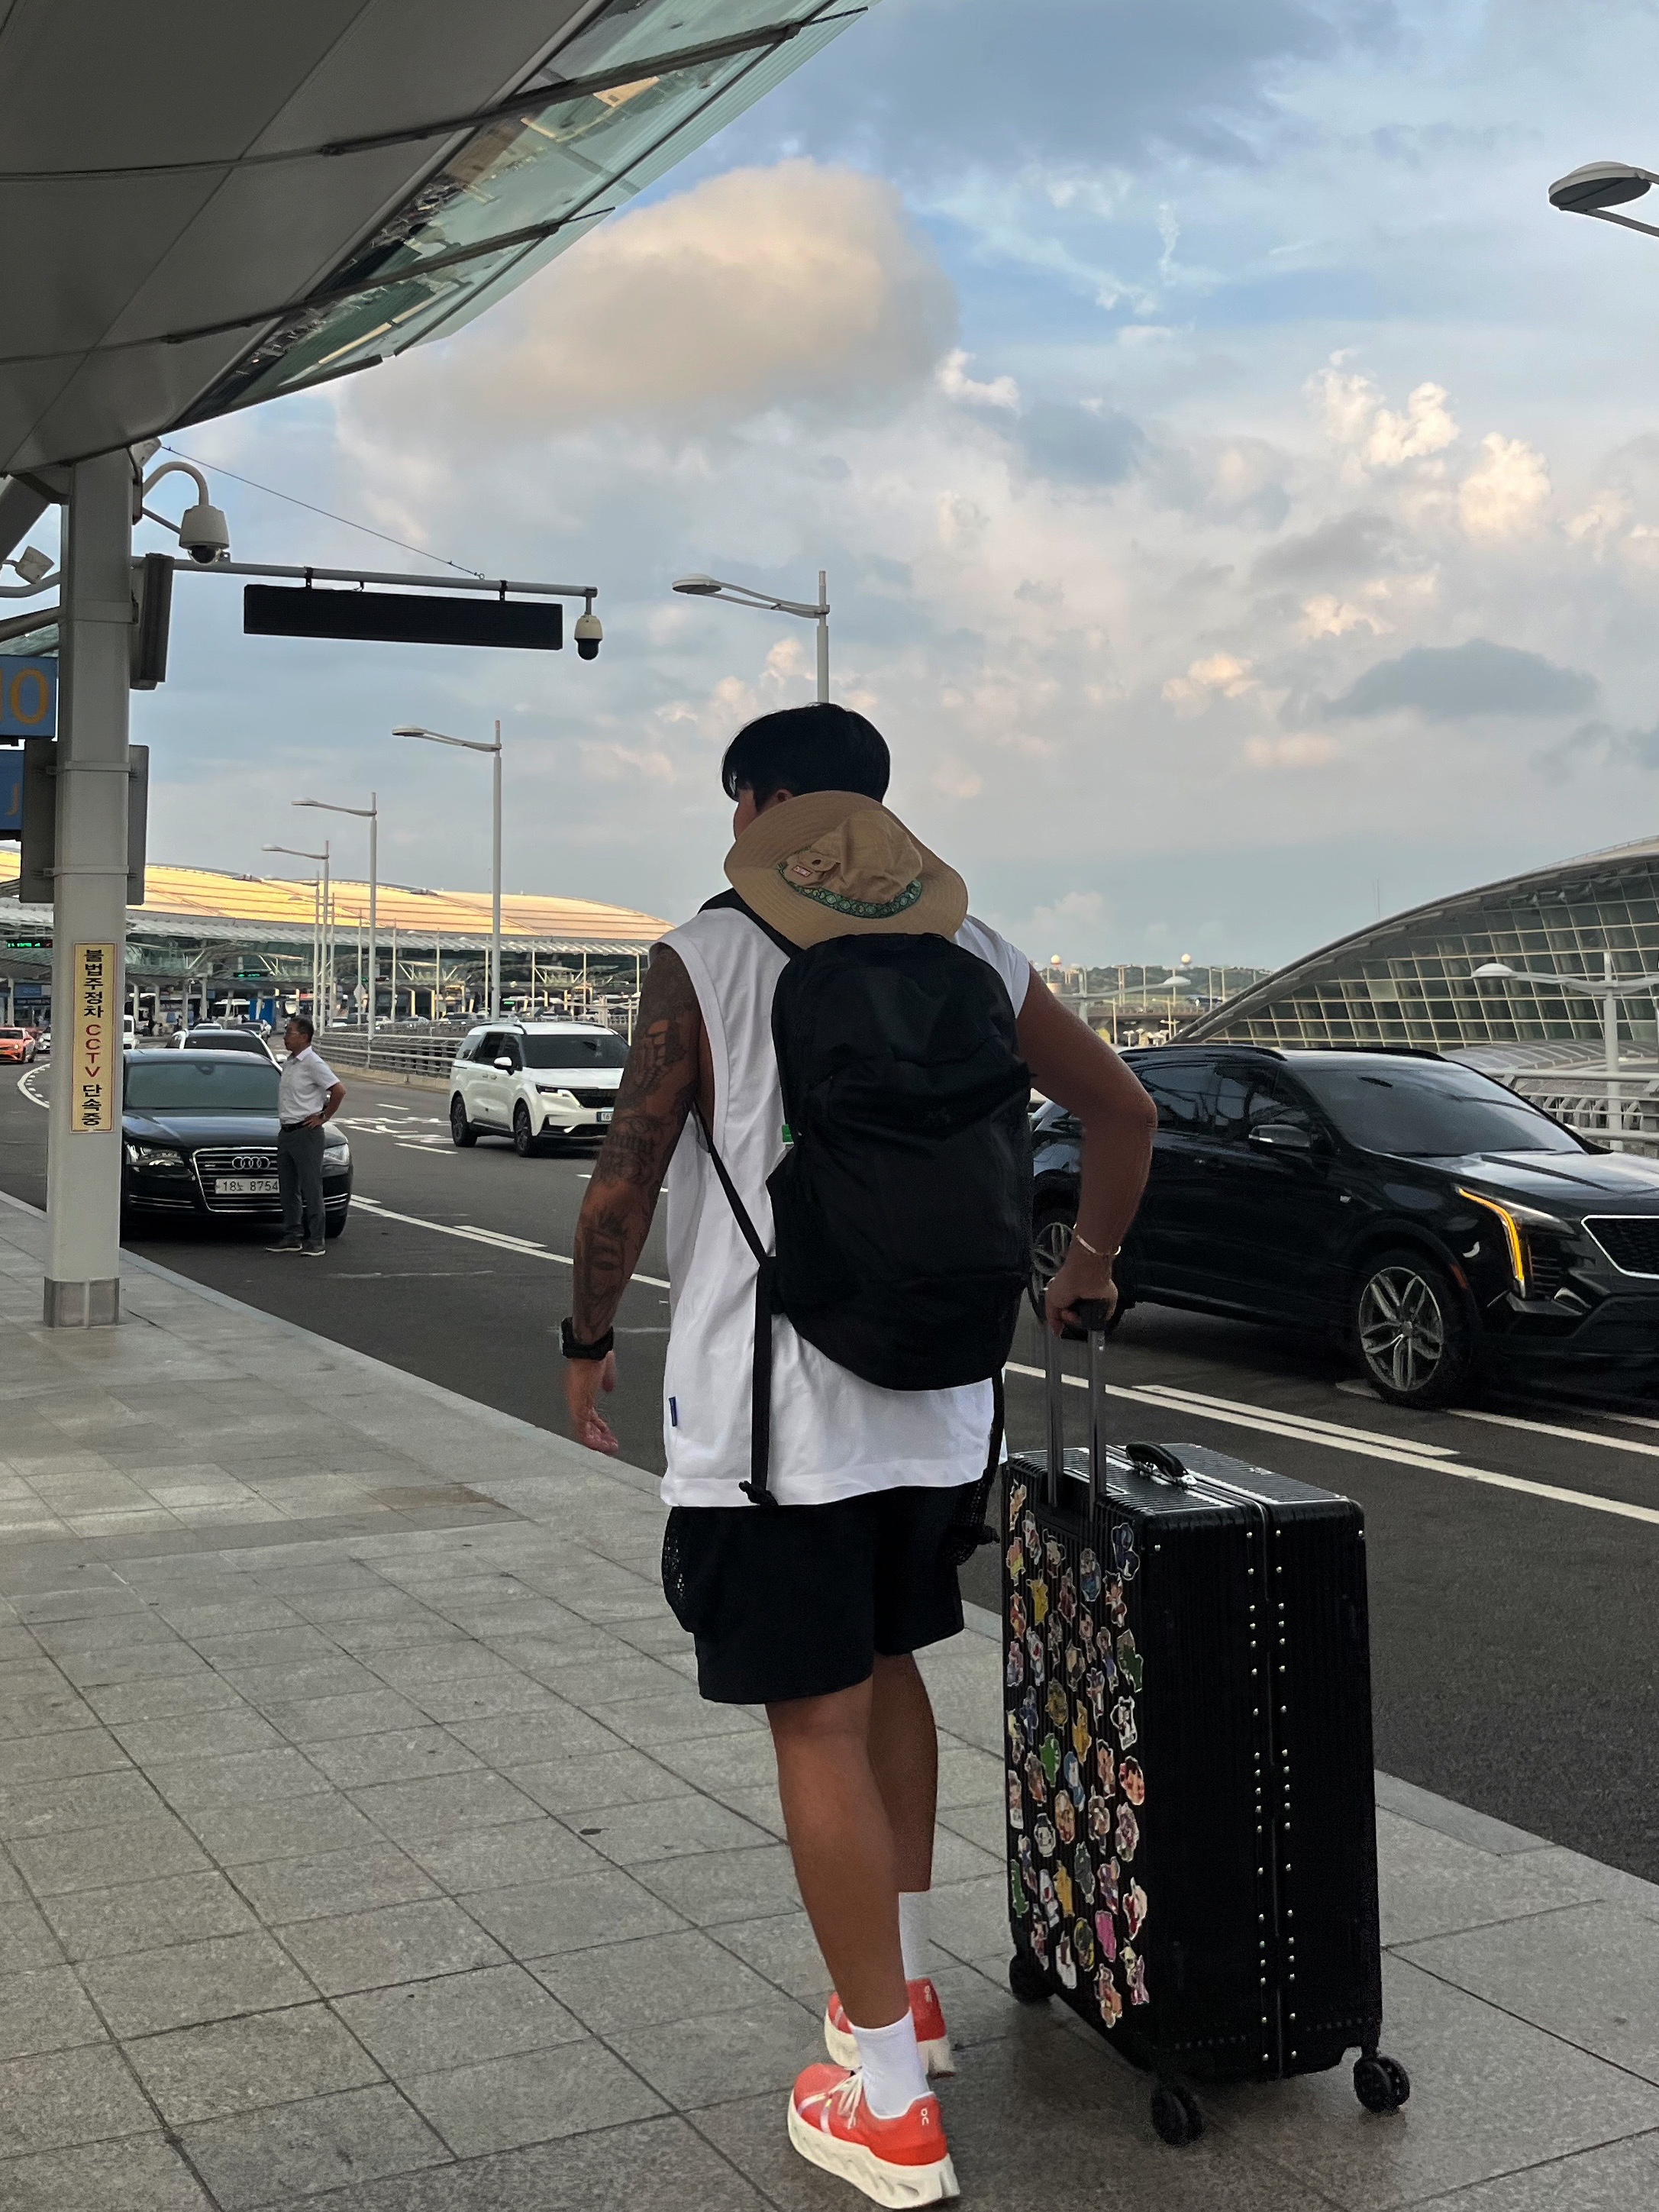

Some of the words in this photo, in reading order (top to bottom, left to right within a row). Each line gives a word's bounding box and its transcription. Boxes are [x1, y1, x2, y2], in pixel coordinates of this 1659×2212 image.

[83, 949, 104, 1019] 불법주정차
[85, 1024, 102, 1078] CCTV
[81, 1083, 102, 1127] 단속중
[250, 1180, 279, 1192] 8754
